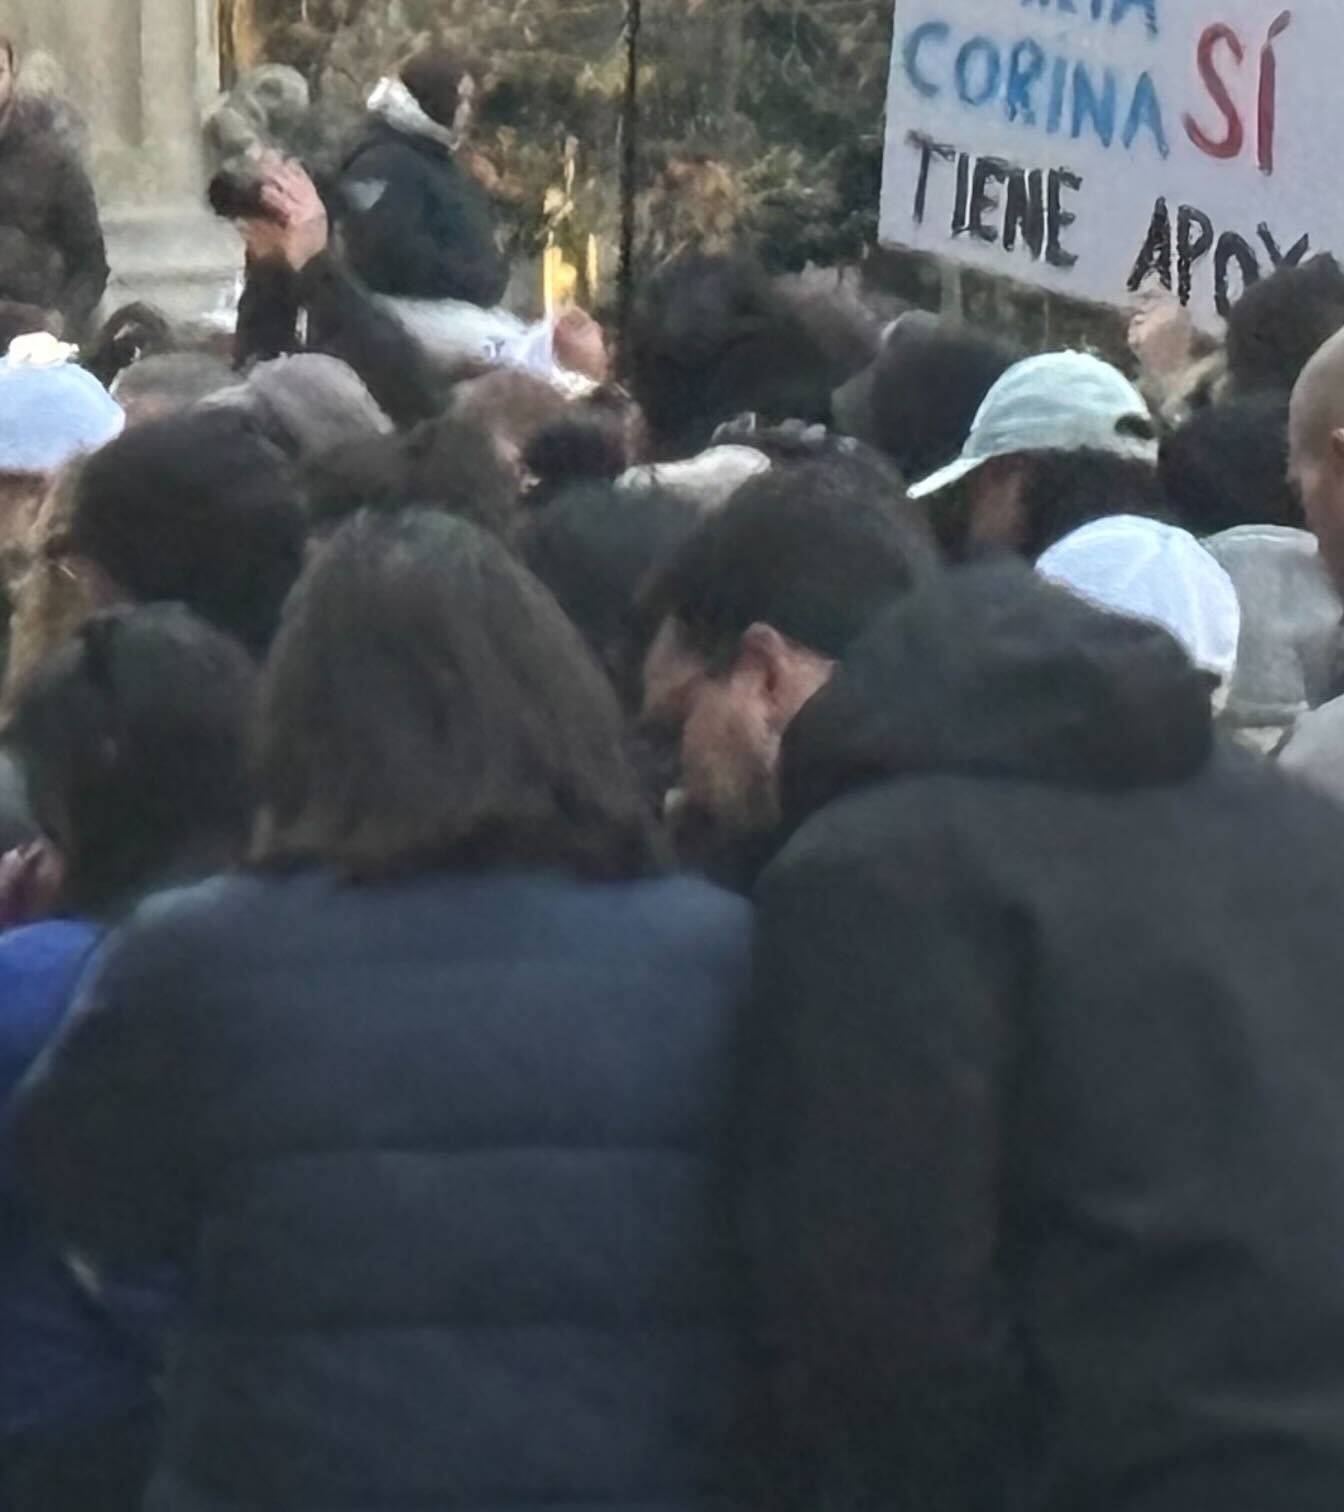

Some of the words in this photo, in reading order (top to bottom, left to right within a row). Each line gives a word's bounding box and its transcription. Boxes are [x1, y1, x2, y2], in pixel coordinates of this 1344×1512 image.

[903, 21, 1170, 160] CORINA
[1182, 9, 1292, 176] SÍ
[906, 129, 1083, 267] TIENE
